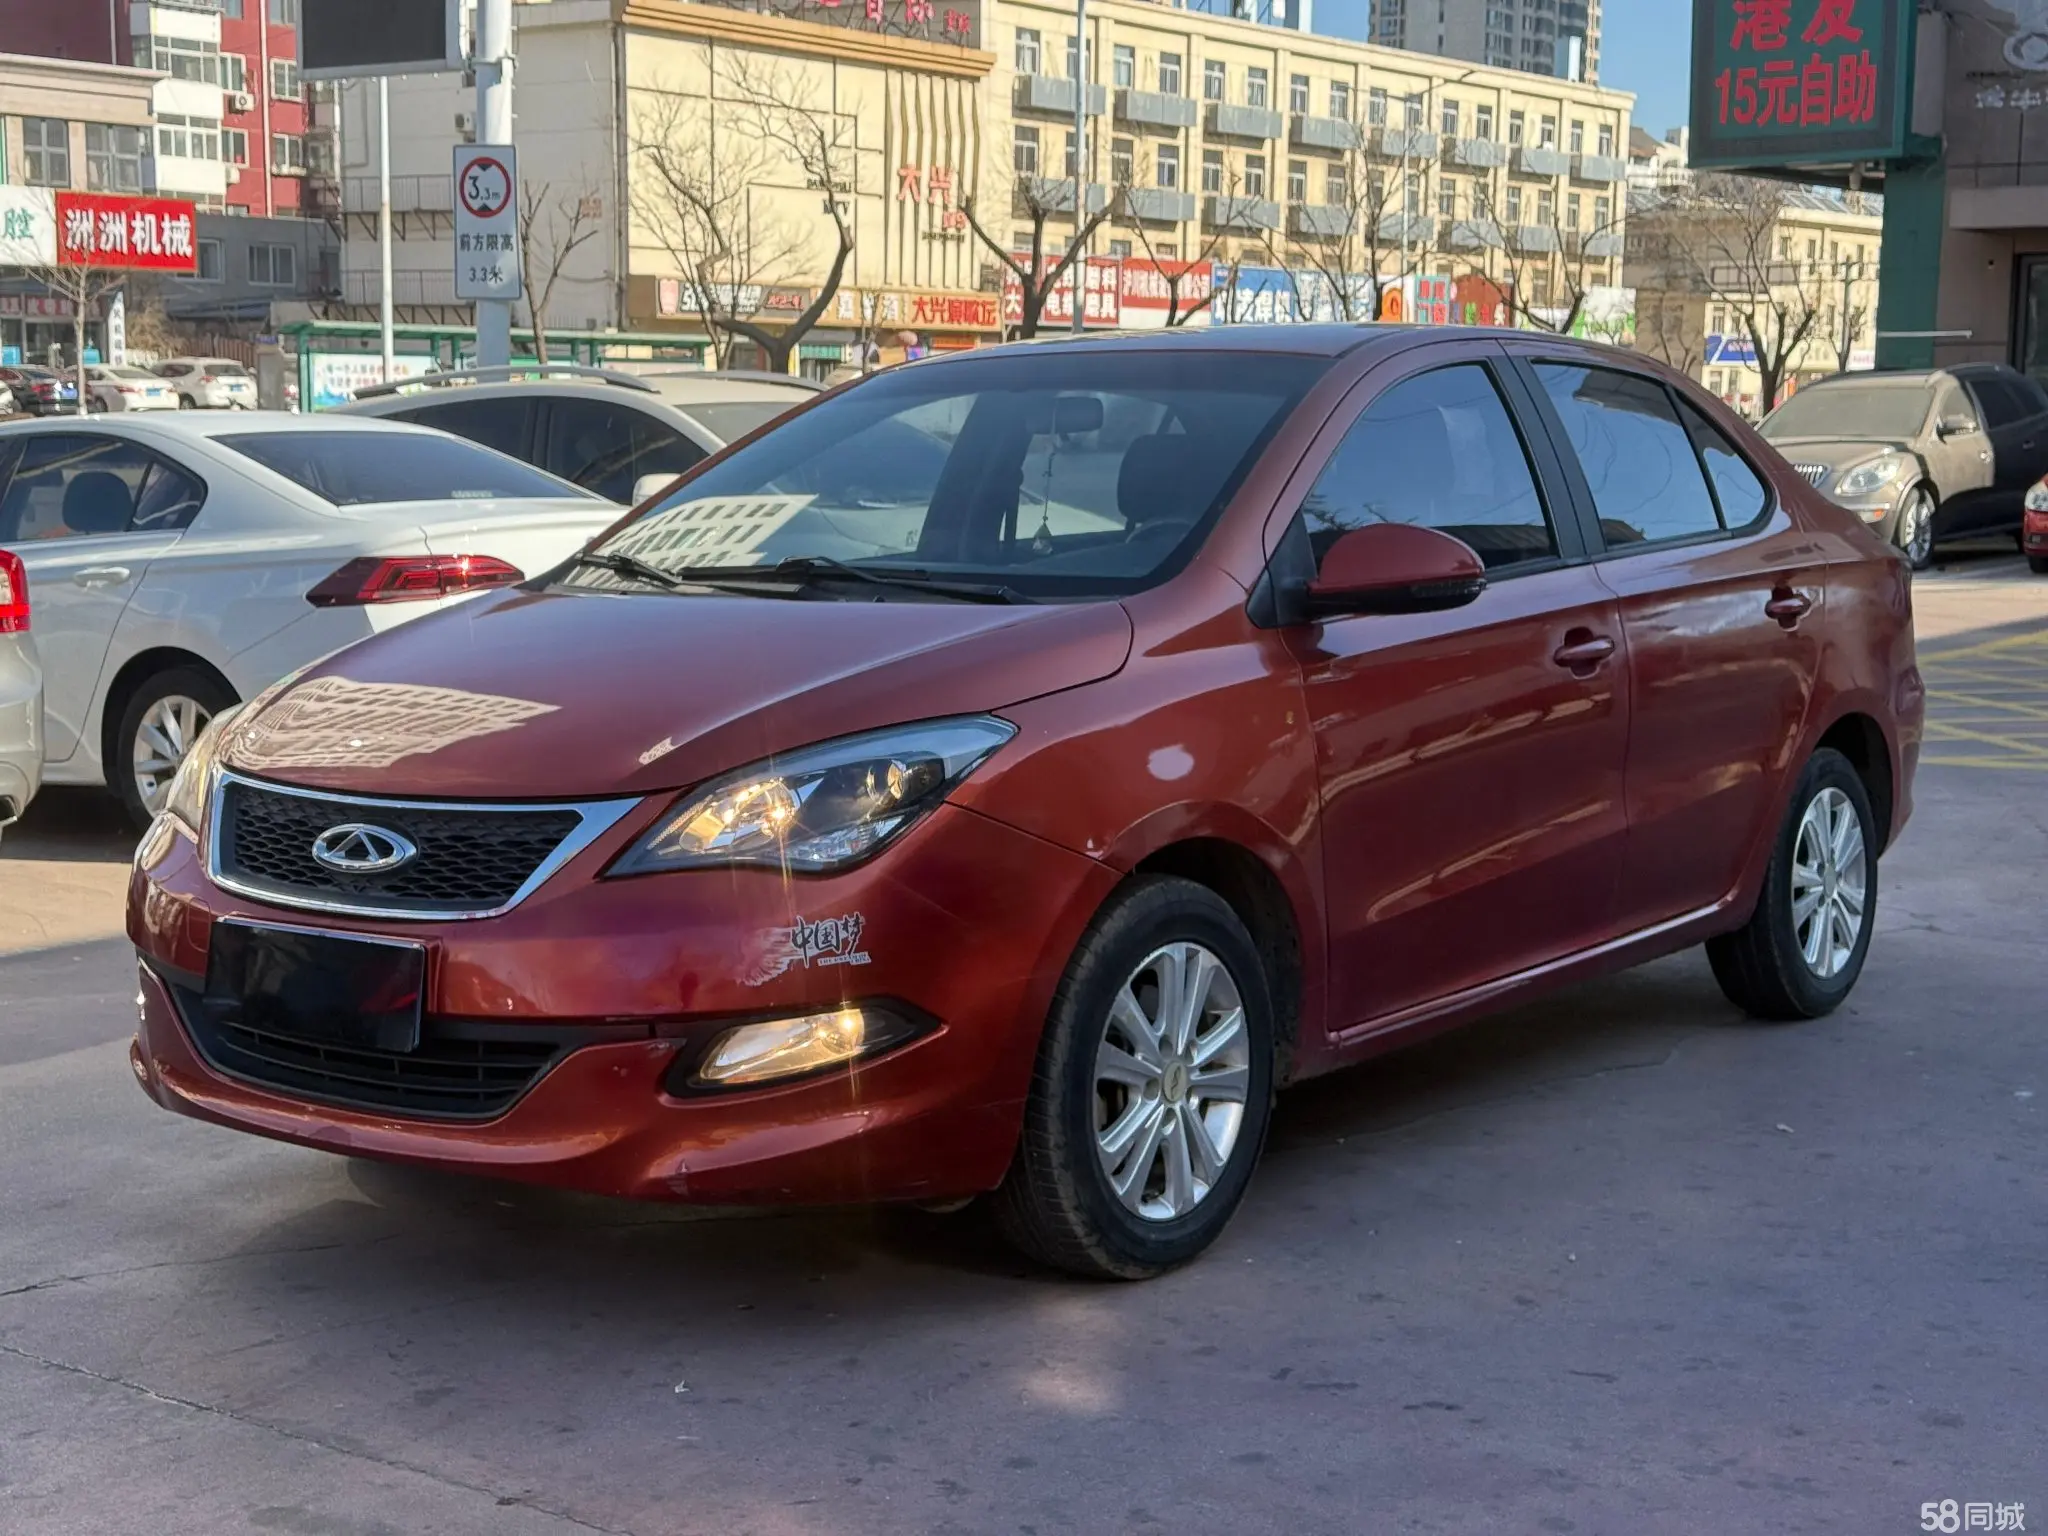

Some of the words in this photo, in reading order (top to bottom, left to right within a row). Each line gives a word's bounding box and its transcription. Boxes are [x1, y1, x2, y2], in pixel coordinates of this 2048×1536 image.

[1715, 50, 1877, 127] 15元自助
[65, 208, 193, 257] 洲洲机械
[460, 232, 513, 252] 前方限高
[468, 265, 503, 284] 3.3米
[791, 912, 864, 968] 中国梦
